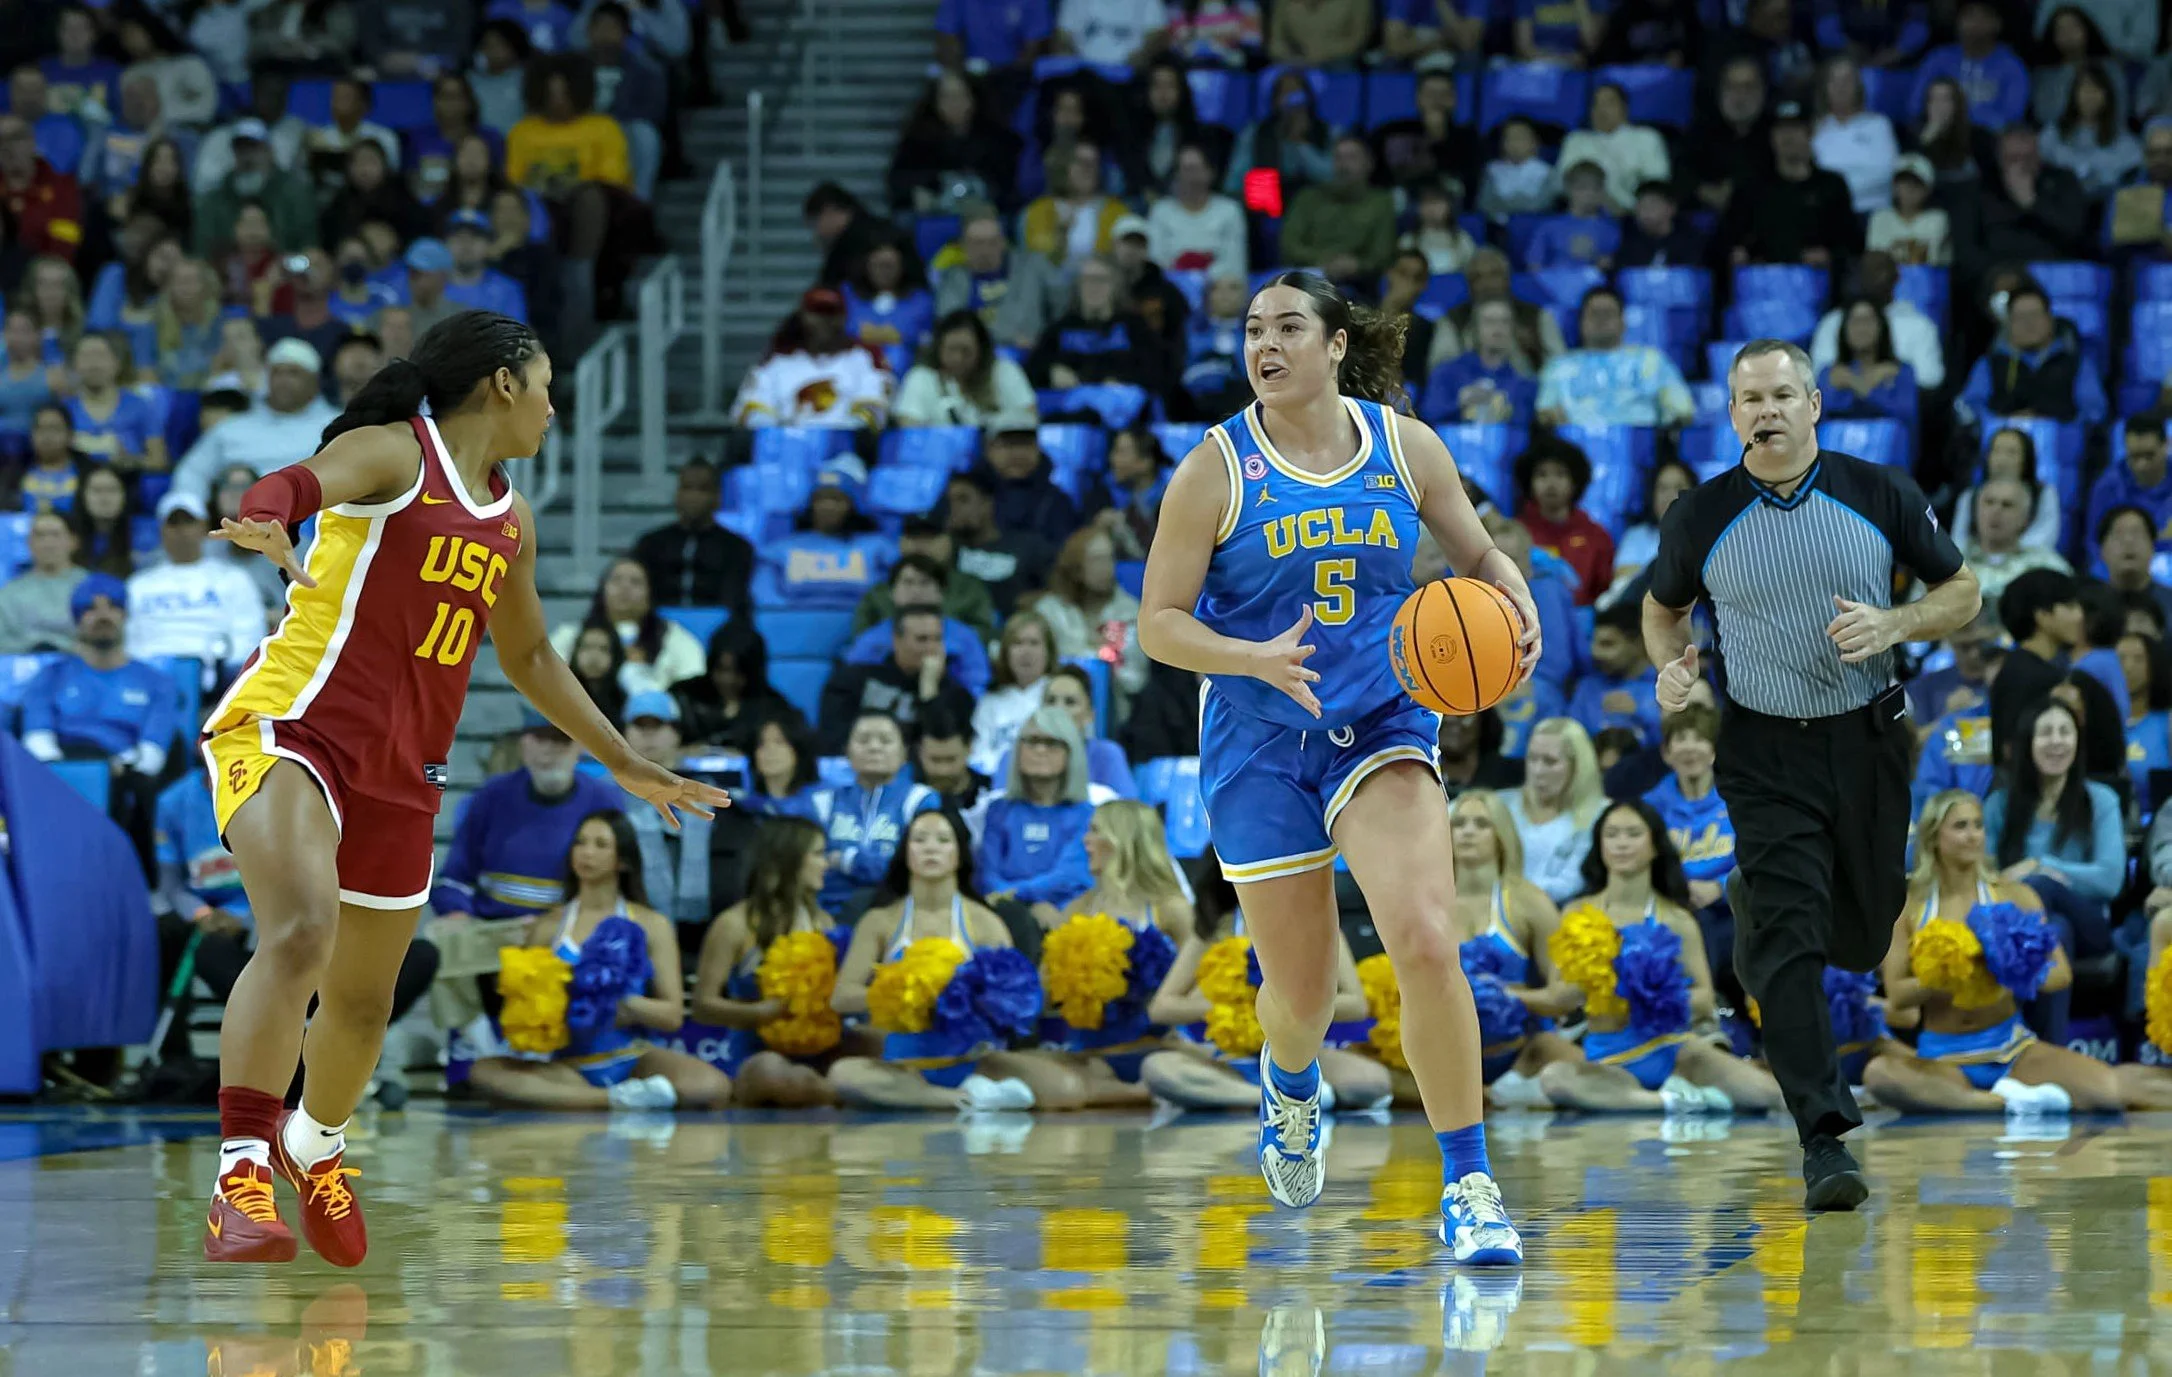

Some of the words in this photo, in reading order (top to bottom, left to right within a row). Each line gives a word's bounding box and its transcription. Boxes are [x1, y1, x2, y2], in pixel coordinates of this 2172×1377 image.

[1263, 506, 1399, 559] UCLA
[419, 536, 508, 609] USC
[1313, 558, 1356, 626] 5
[414, 602, 475, 666] 10
